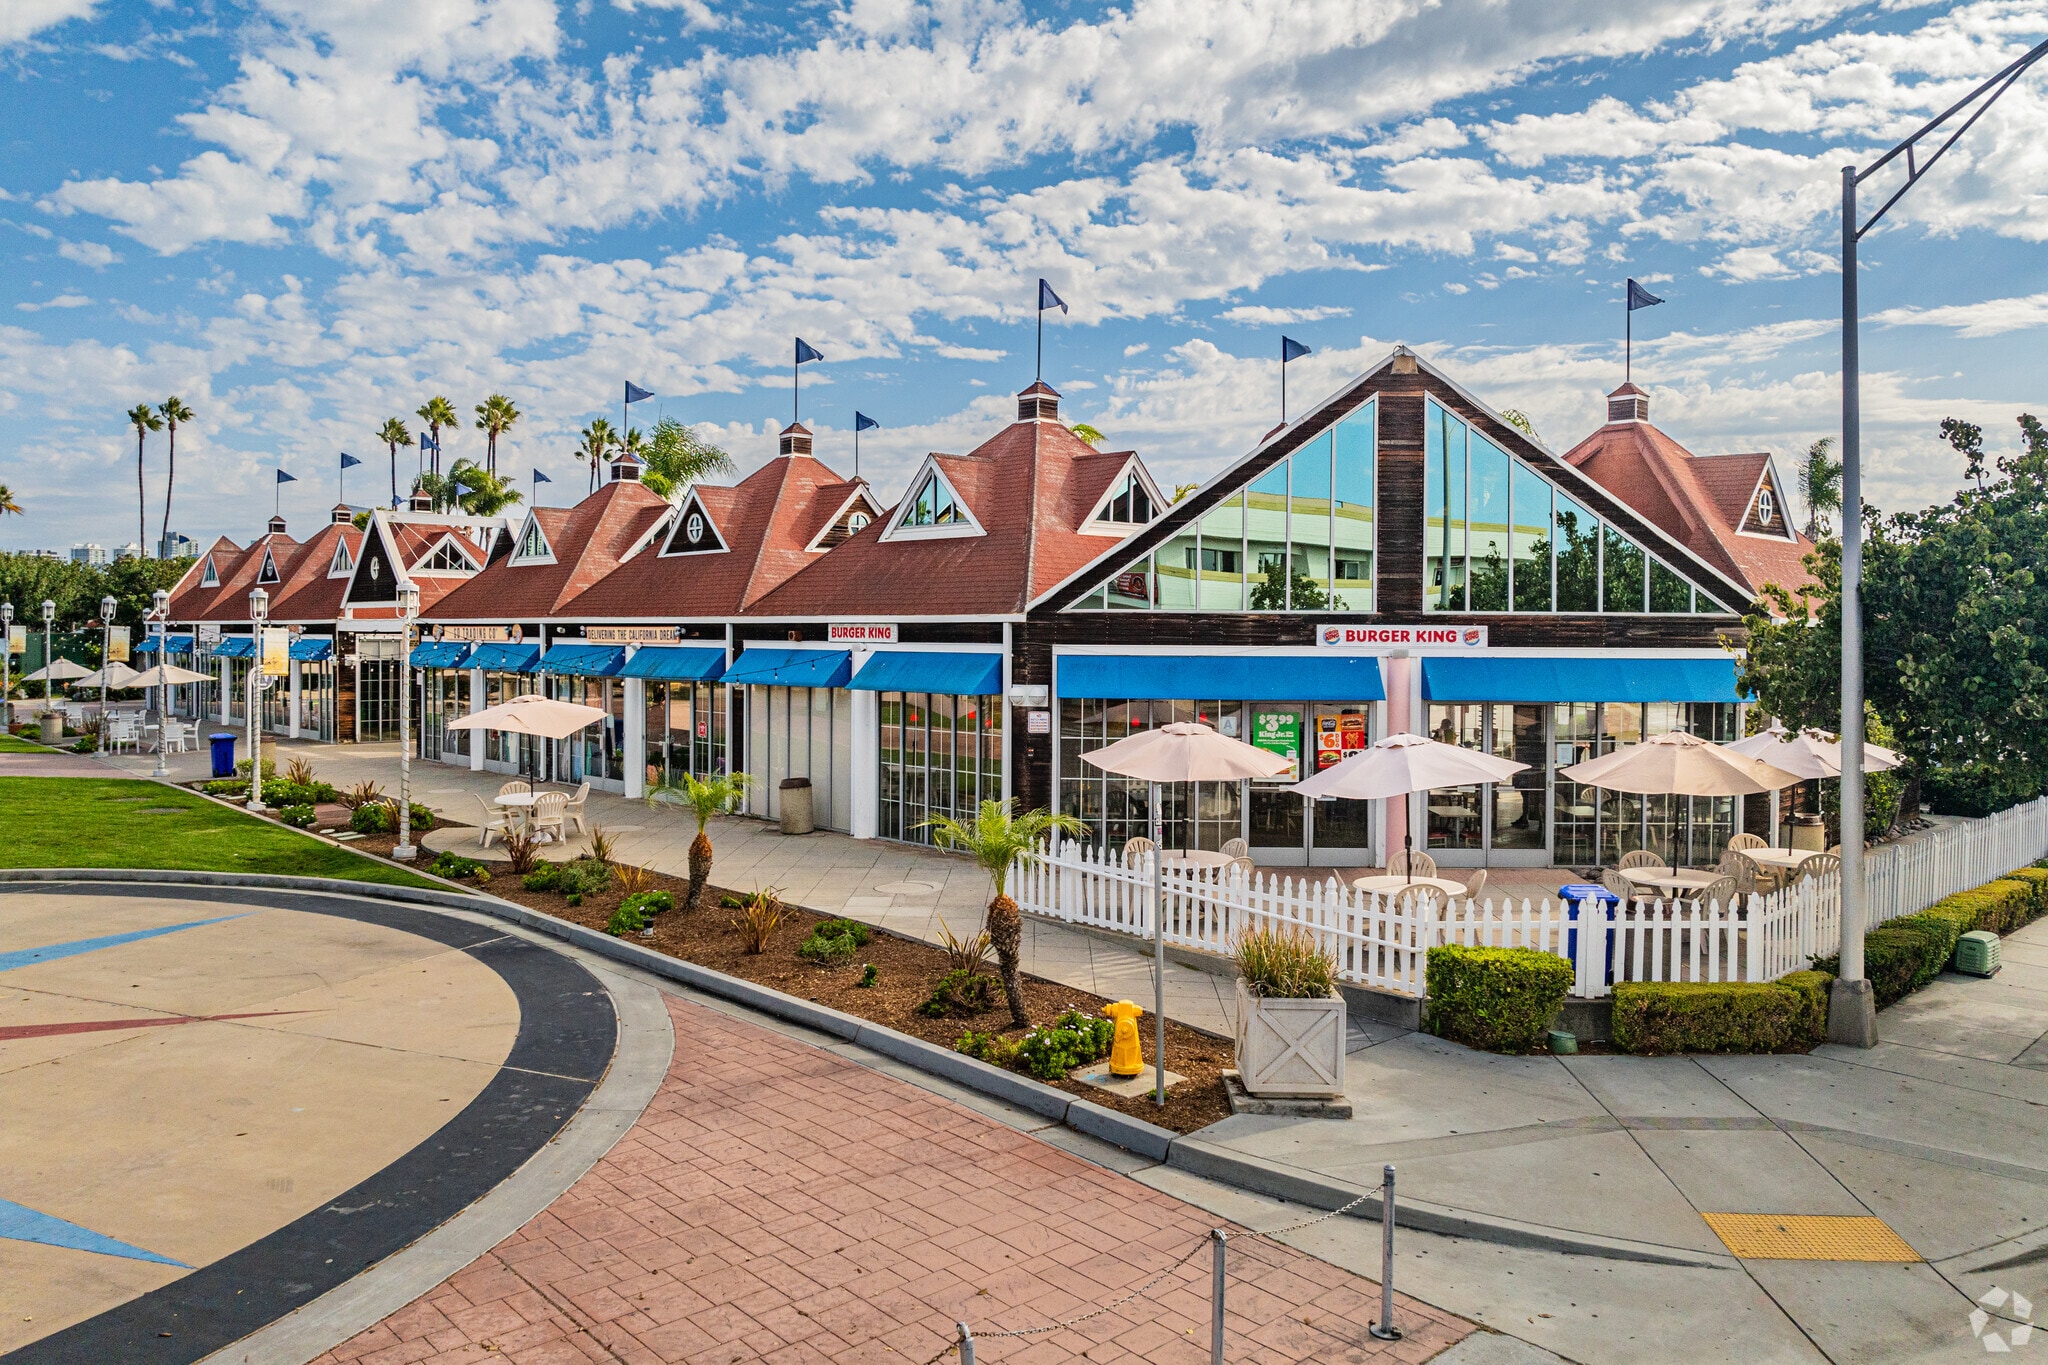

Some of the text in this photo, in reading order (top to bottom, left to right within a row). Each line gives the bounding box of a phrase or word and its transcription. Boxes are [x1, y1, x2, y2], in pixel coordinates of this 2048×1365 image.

[462, 627, 486, 639] TRADING
[588, 629, 615, 640] DELIVERING
[617, 629, 627, 640] THE
[629, 629, 658, 640] CALIFORNIA
[831, 627, 891, 639] BURGER KING
[1345, 629, 1457, 643] BURGER KING
[1259, 731, 1276, 739] King
[1319, 733, 1335, 748] $6
